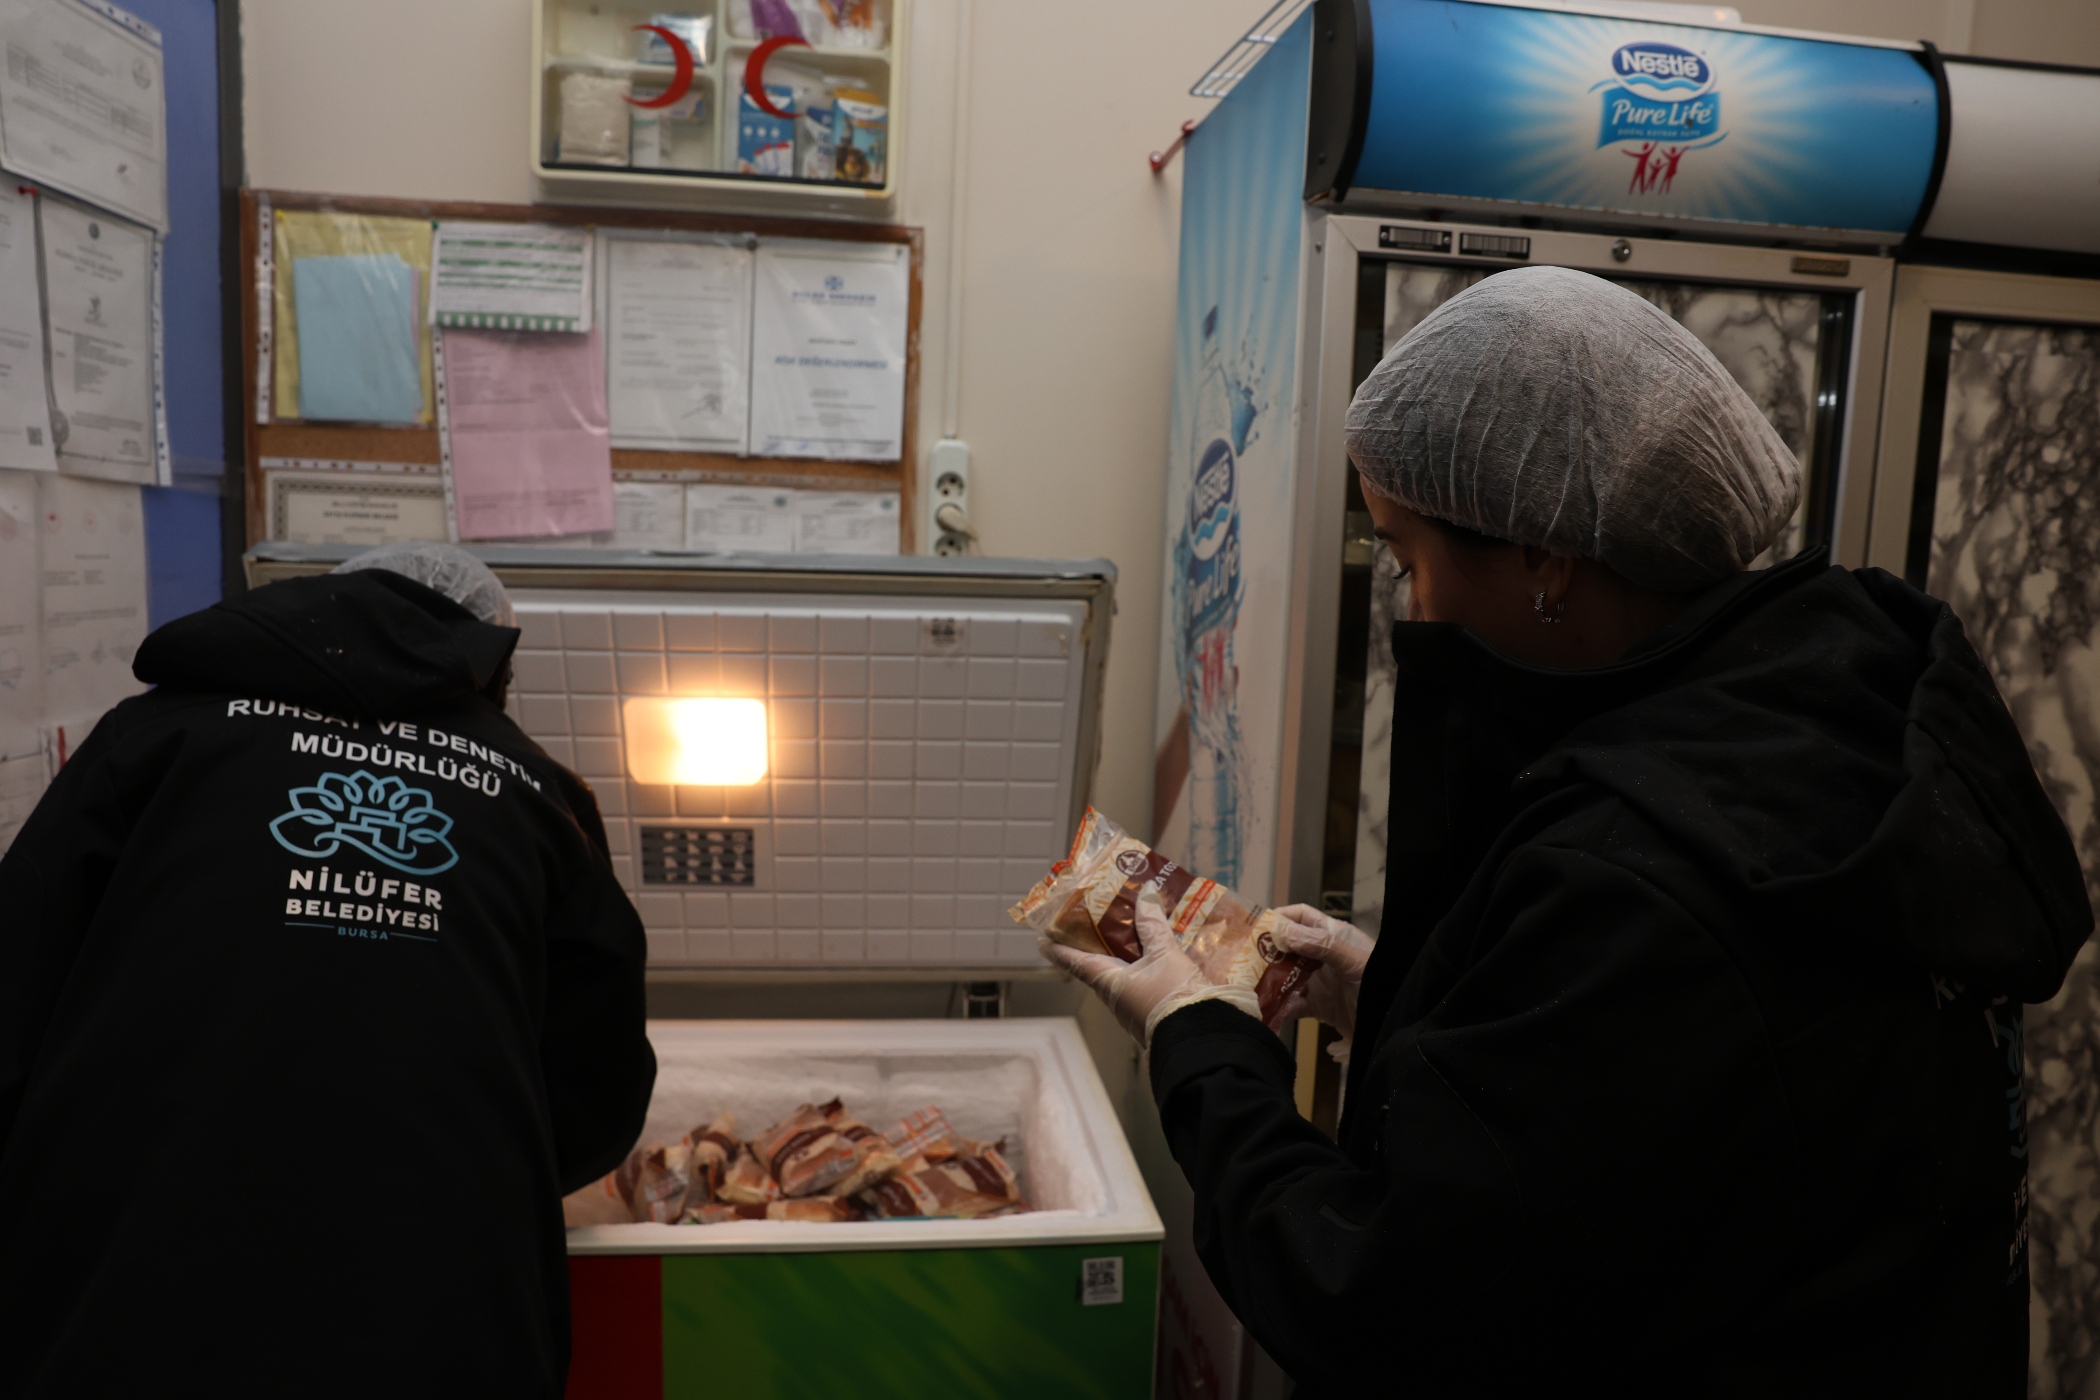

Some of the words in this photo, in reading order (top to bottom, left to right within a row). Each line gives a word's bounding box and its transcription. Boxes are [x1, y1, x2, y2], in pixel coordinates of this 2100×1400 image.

[1611, 98, 1666, 125] Pure
[1667, 101, 1713, 128] Life
[1212, 536, 1240, 597] Life
[377, 720, 419, 741] VE
[290, 731, 502, 797] MÜDÜRLÜĞÜ
[288, 865, 443, 911] NİLÜFER
[285, 897, 440, 932] BELEDİYESİ
[337, 926, 389, 941] BURSA
